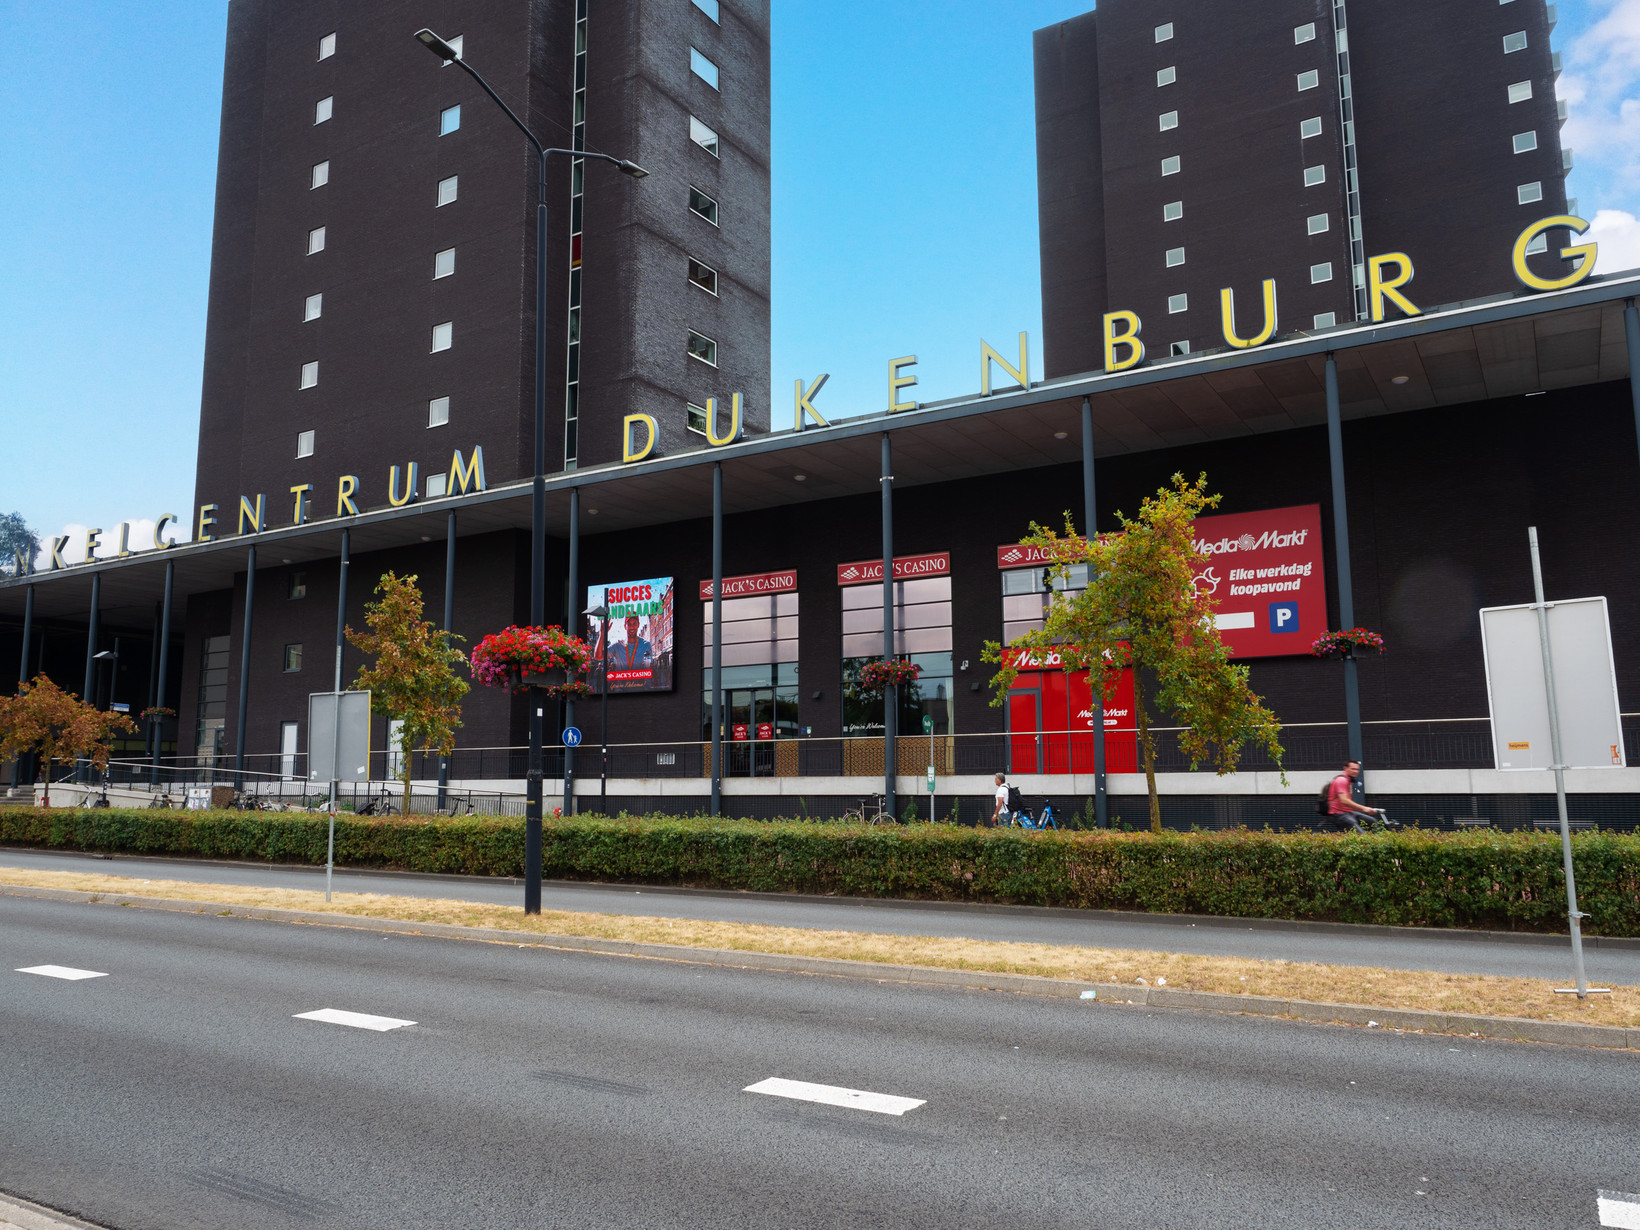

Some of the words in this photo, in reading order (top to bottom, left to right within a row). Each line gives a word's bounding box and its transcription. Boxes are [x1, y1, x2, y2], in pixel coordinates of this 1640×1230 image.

[621, 214, 1598, 464] DUKENBURG
[1252, 529, 1308, 551] Markt
[861, 563, 902, 578] JAC'S
[904, 558, 946, 574] CASINO
[1229, 568, 1255, 581] Elke
[1256, 562, 1313, 578] werkdag
[608, 584, 652, 603] SUCCES
[721, 580, 755, 594] JACK'S
[757, 575, 794, 590] CASINO
[1230, 578, 1301, 596] koopavond
[598, 601, 664, 620] NDELAARS
[1276, 608, 1292, 627] P
[632, 670, 652, 678] CASINO
